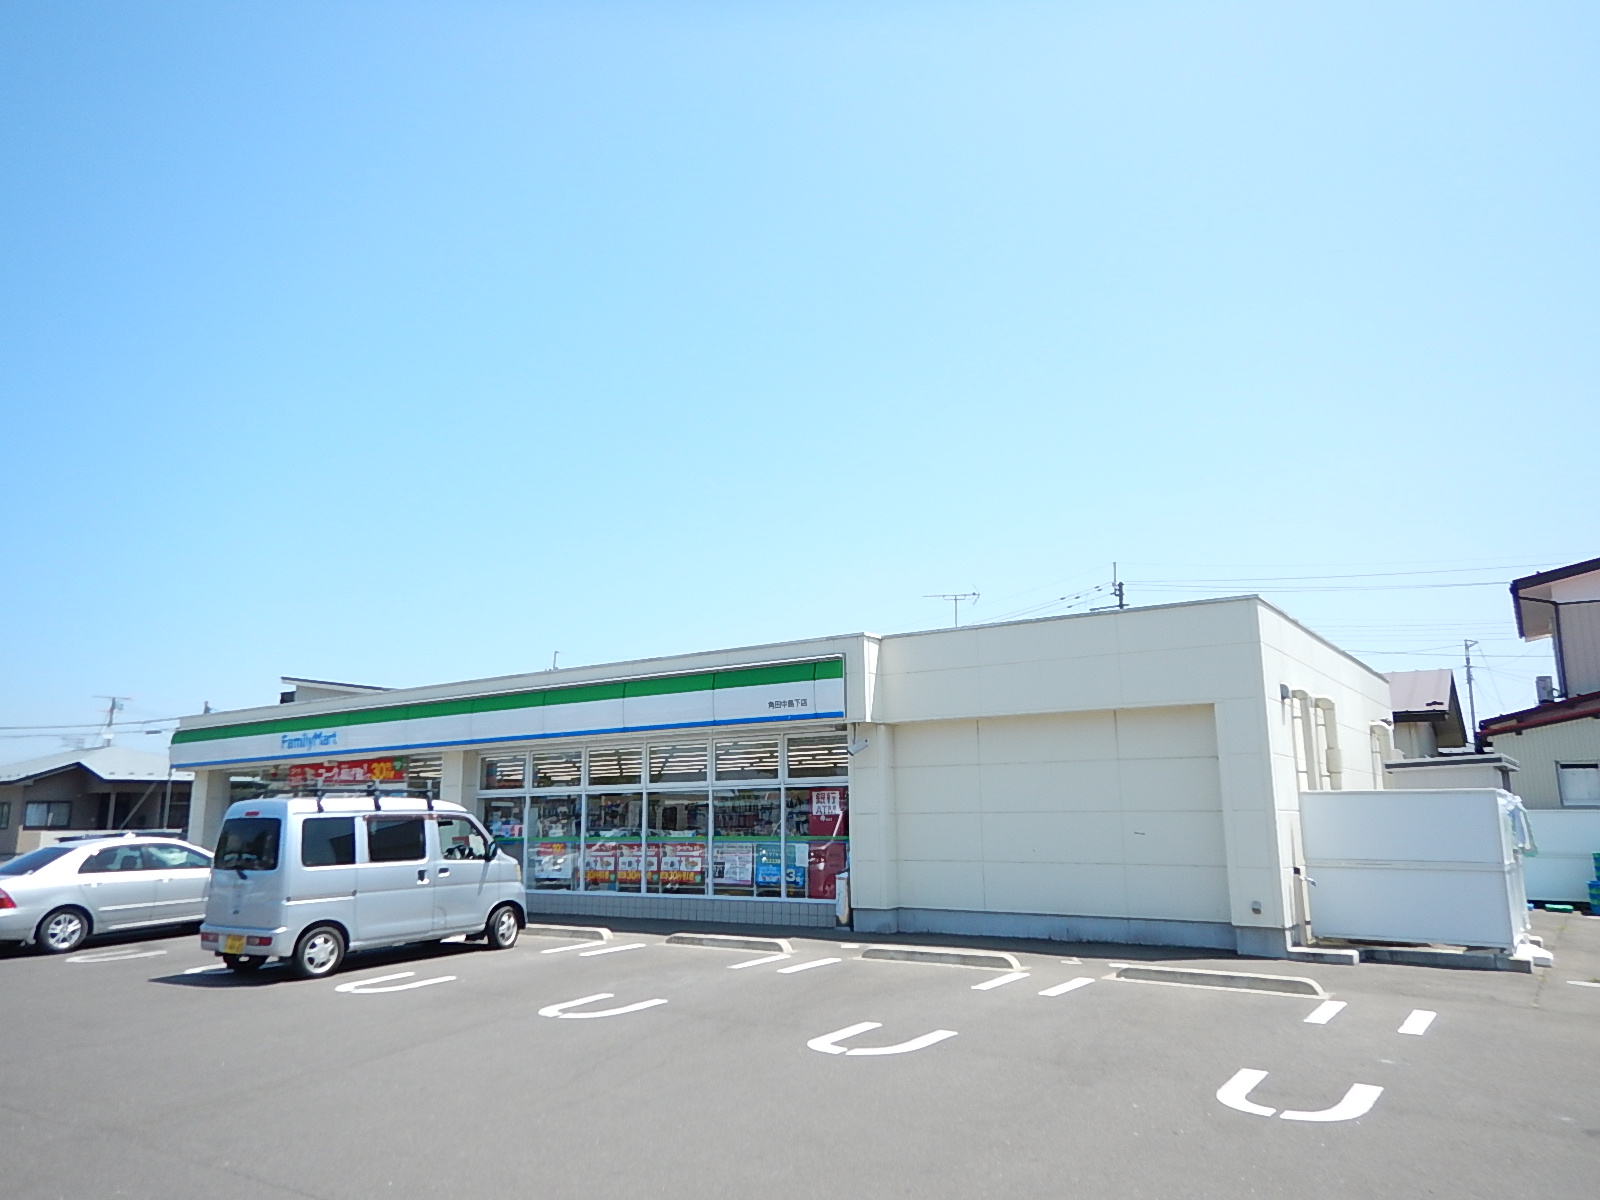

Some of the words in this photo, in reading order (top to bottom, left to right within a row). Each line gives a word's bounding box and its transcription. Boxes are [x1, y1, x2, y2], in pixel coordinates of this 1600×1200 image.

[768, 698, 808, 709] 角田中島下店
[281, 731, 337, 751] FamilyMart
[816, 792, 836, 805] 銀行
[816, 805, 836, 815] ATM
